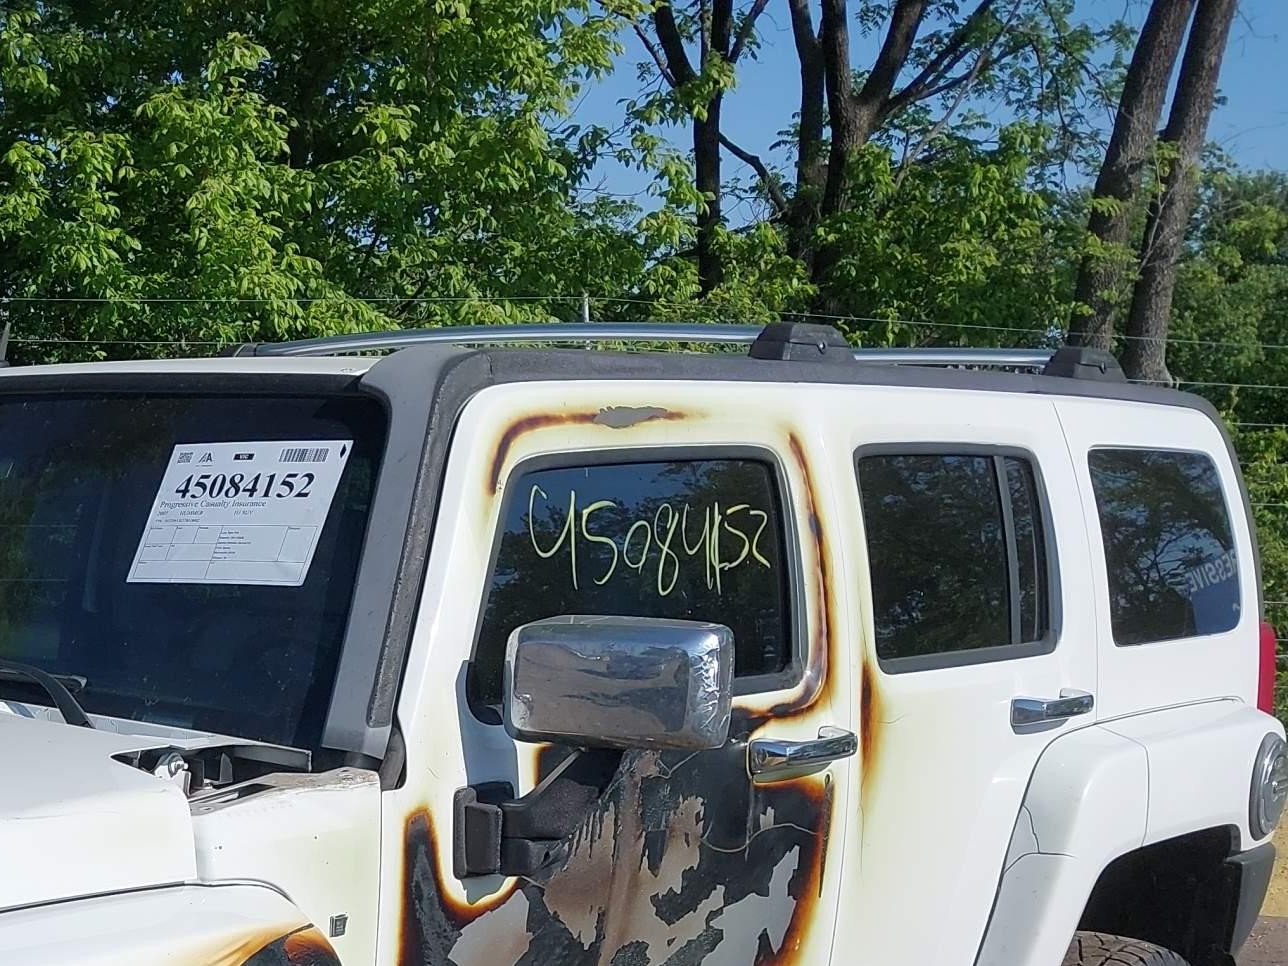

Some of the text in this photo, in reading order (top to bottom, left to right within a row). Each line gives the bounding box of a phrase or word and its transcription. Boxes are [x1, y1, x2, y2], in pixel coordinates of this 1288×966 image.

[175, 473, 315, 499] 45084152
[159, 500, 266, 509] Progressive Casualty Insurance
[529, 484, 771, 596] 45084152
